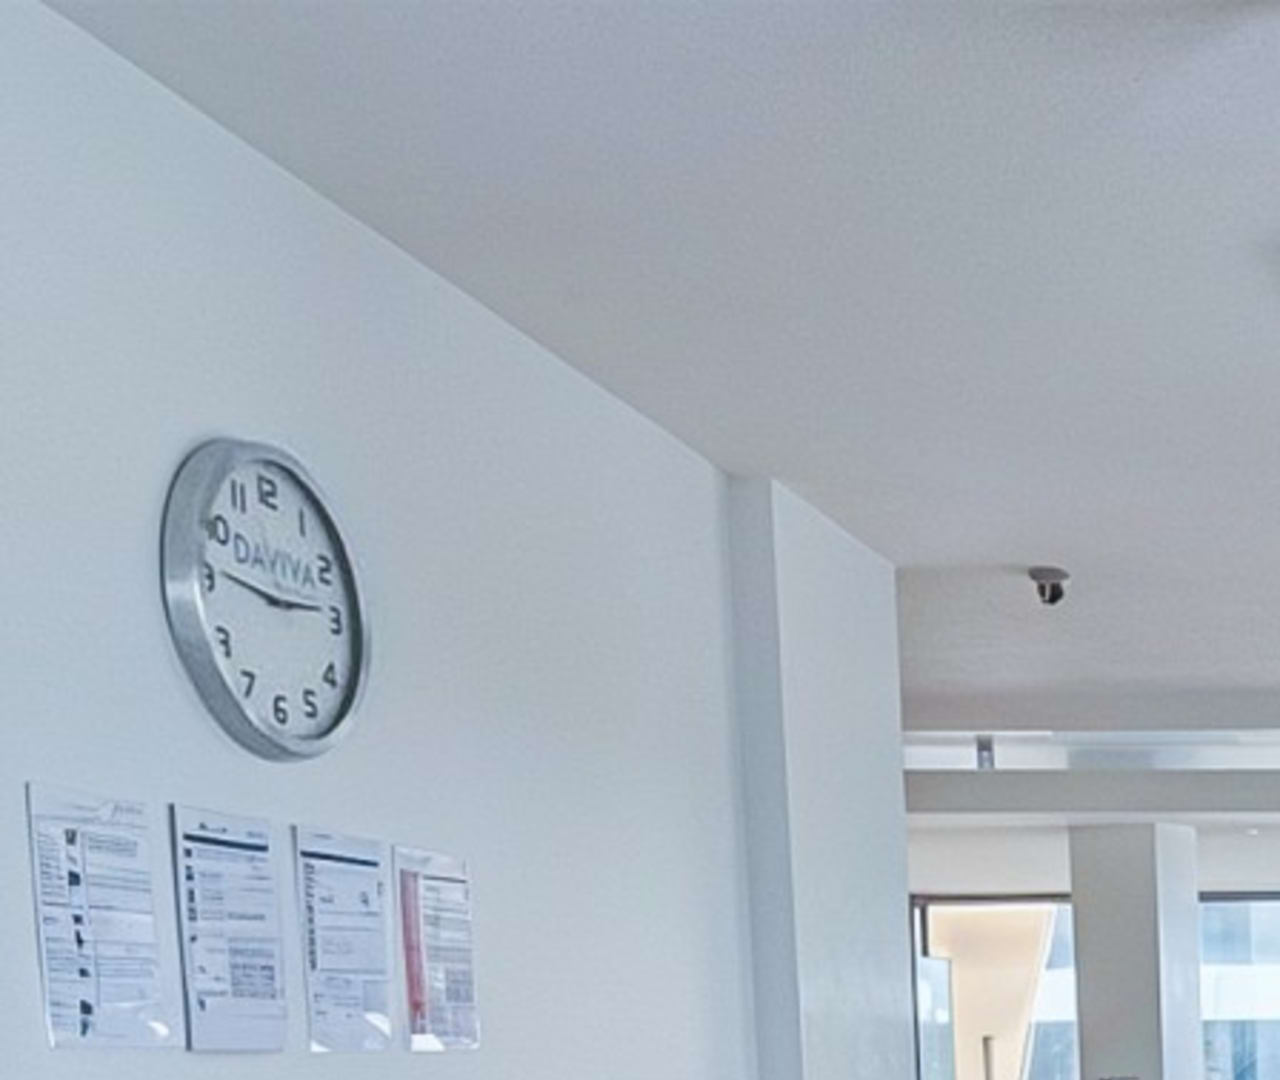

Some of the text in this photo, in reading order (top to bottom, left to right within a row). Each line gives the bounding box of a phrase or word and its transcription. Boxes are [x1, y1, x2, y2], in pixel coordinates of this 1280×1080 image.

[230, 478, 247, 515] 11
[299, 506, 307, 537] 1
[316, 553, 333, 587] 2
[328, 605, 343, 635] 3
[240, 669, 256, 700] 7
[322, 661, 338, 690] 4
[272, 695, 288, 726] 6
[302, 688, 318, 719] 5
